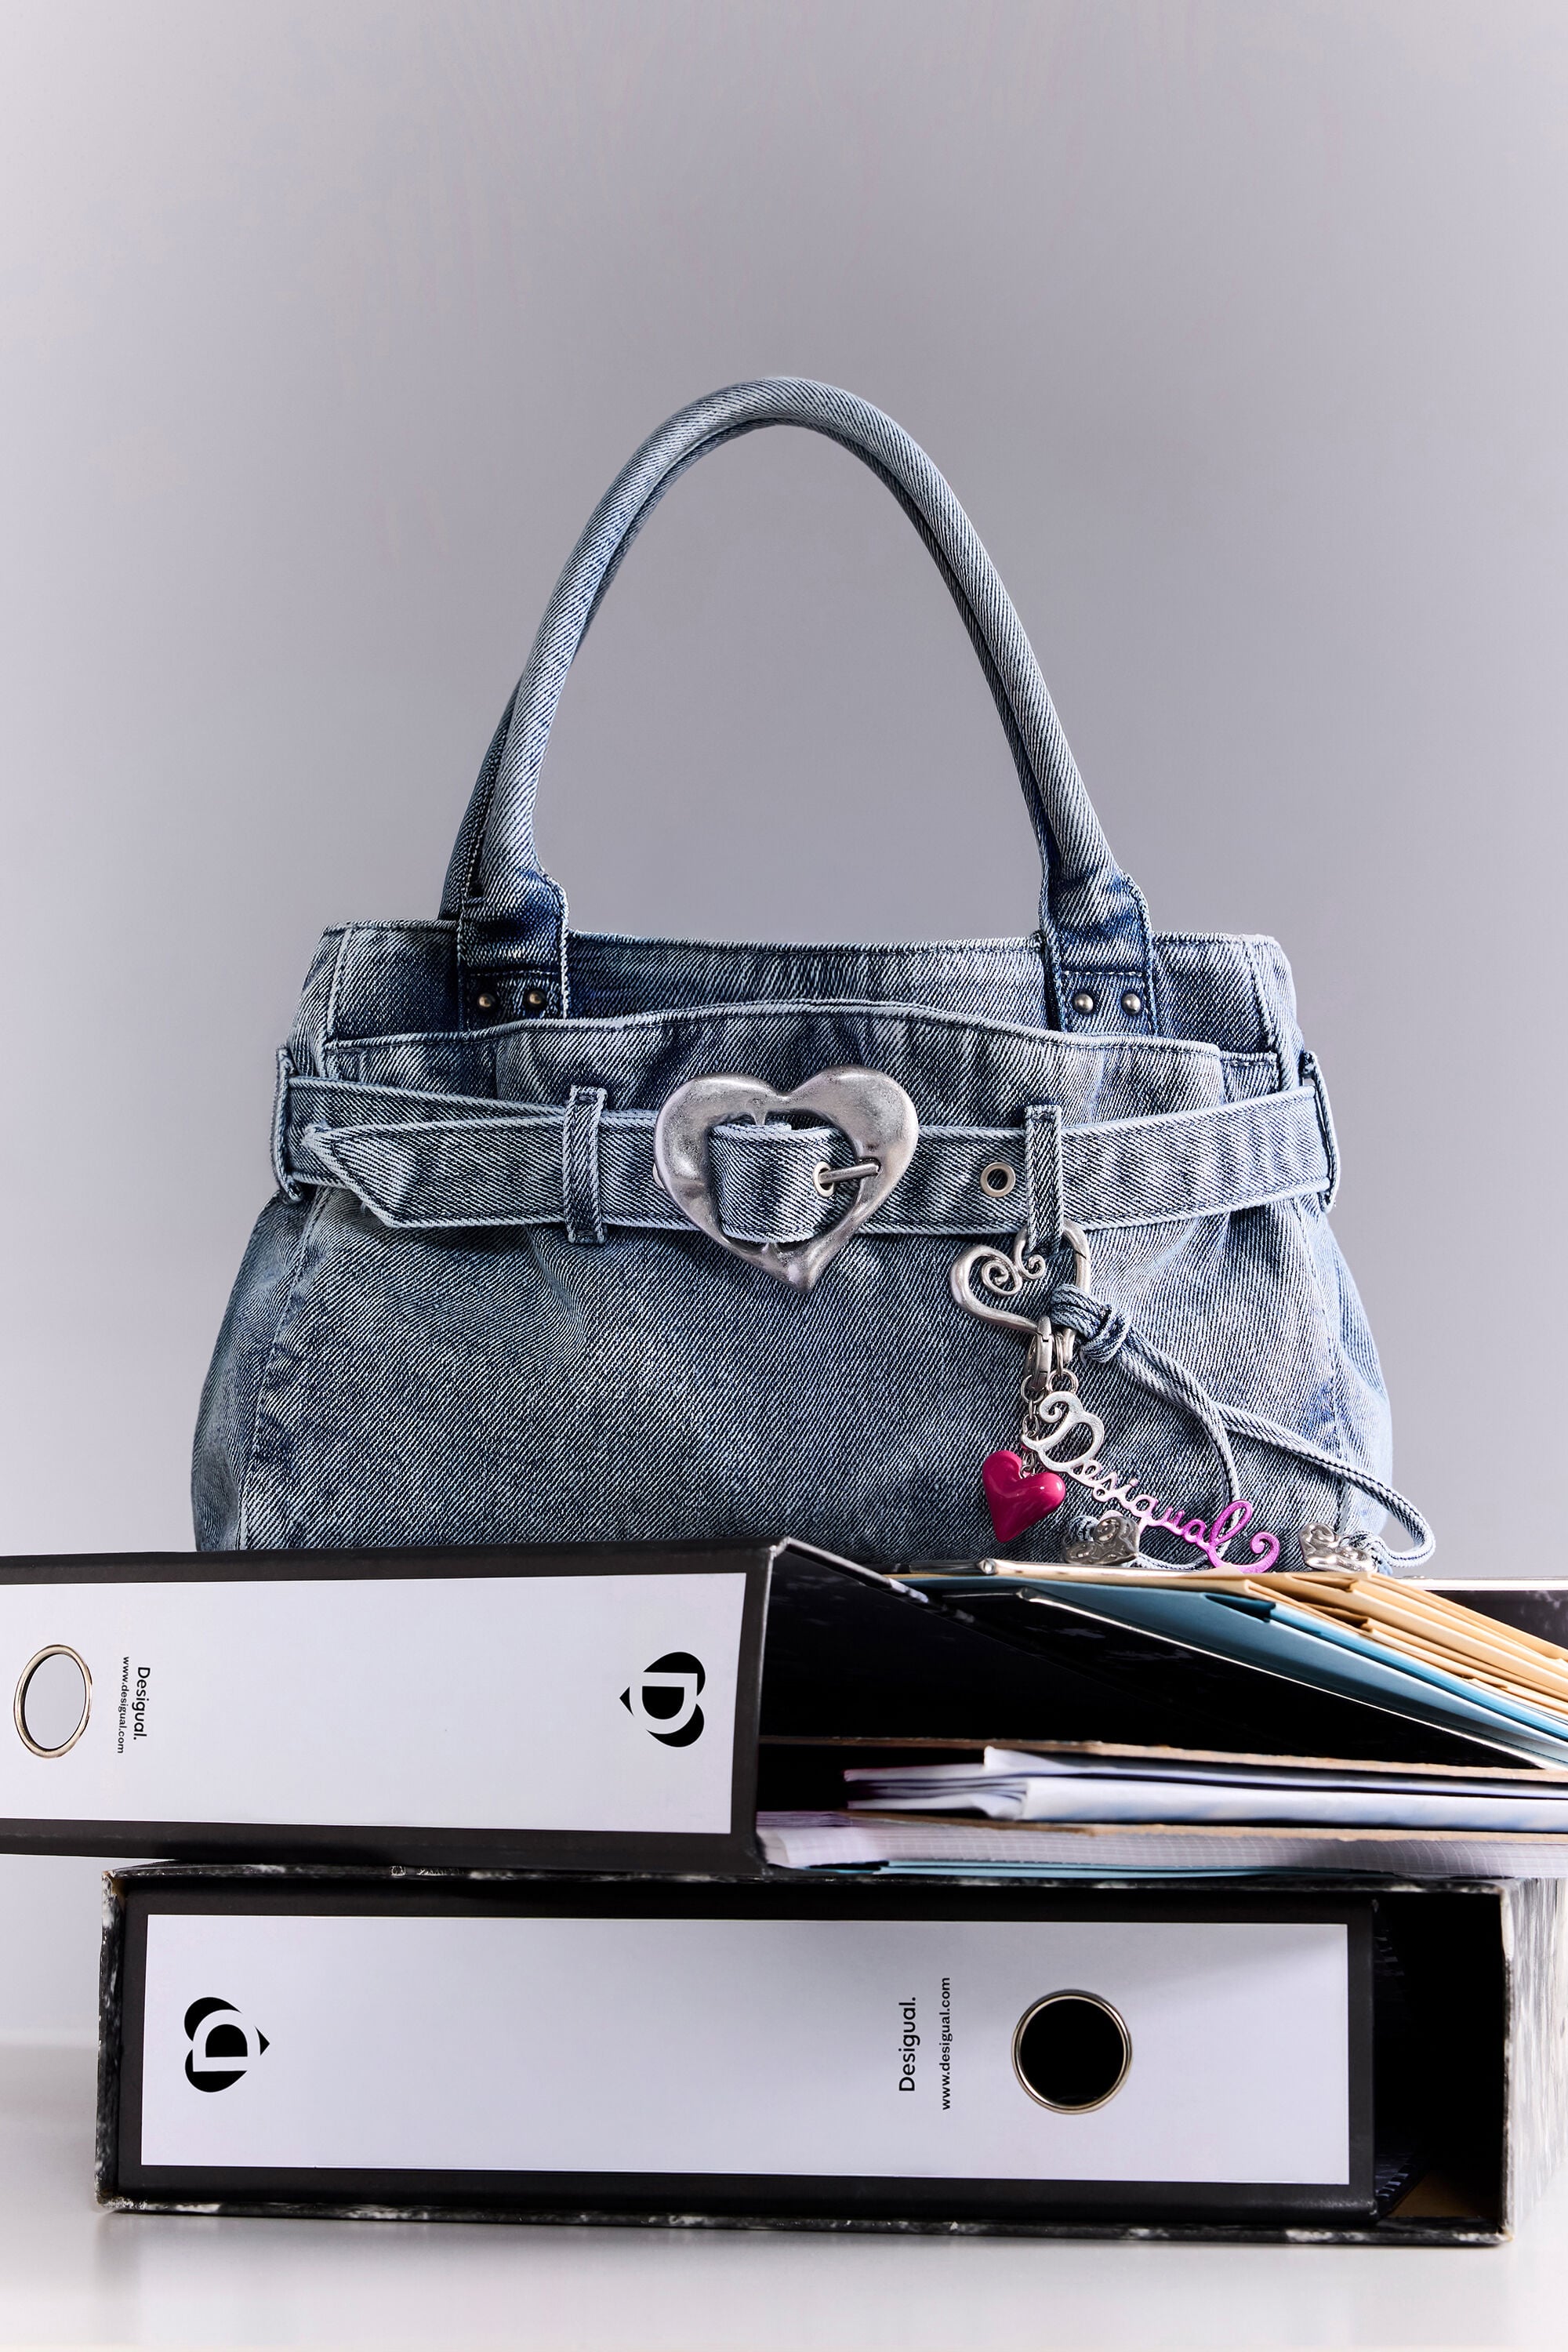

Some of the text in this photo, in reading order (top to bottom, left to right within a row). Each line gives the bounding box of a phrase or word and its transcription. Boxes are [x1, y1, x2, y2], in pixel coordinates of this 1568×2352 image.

[1021, 1390, 1280, 1573] Desigual
[117, 1656, 129, 1754] www.desigual.com
[131, 1666, 151, 1740] Desigual.
[898, 1997, 921, 2092] Desigual.
[938, 1977, 953, 2111] www.desigual.com
